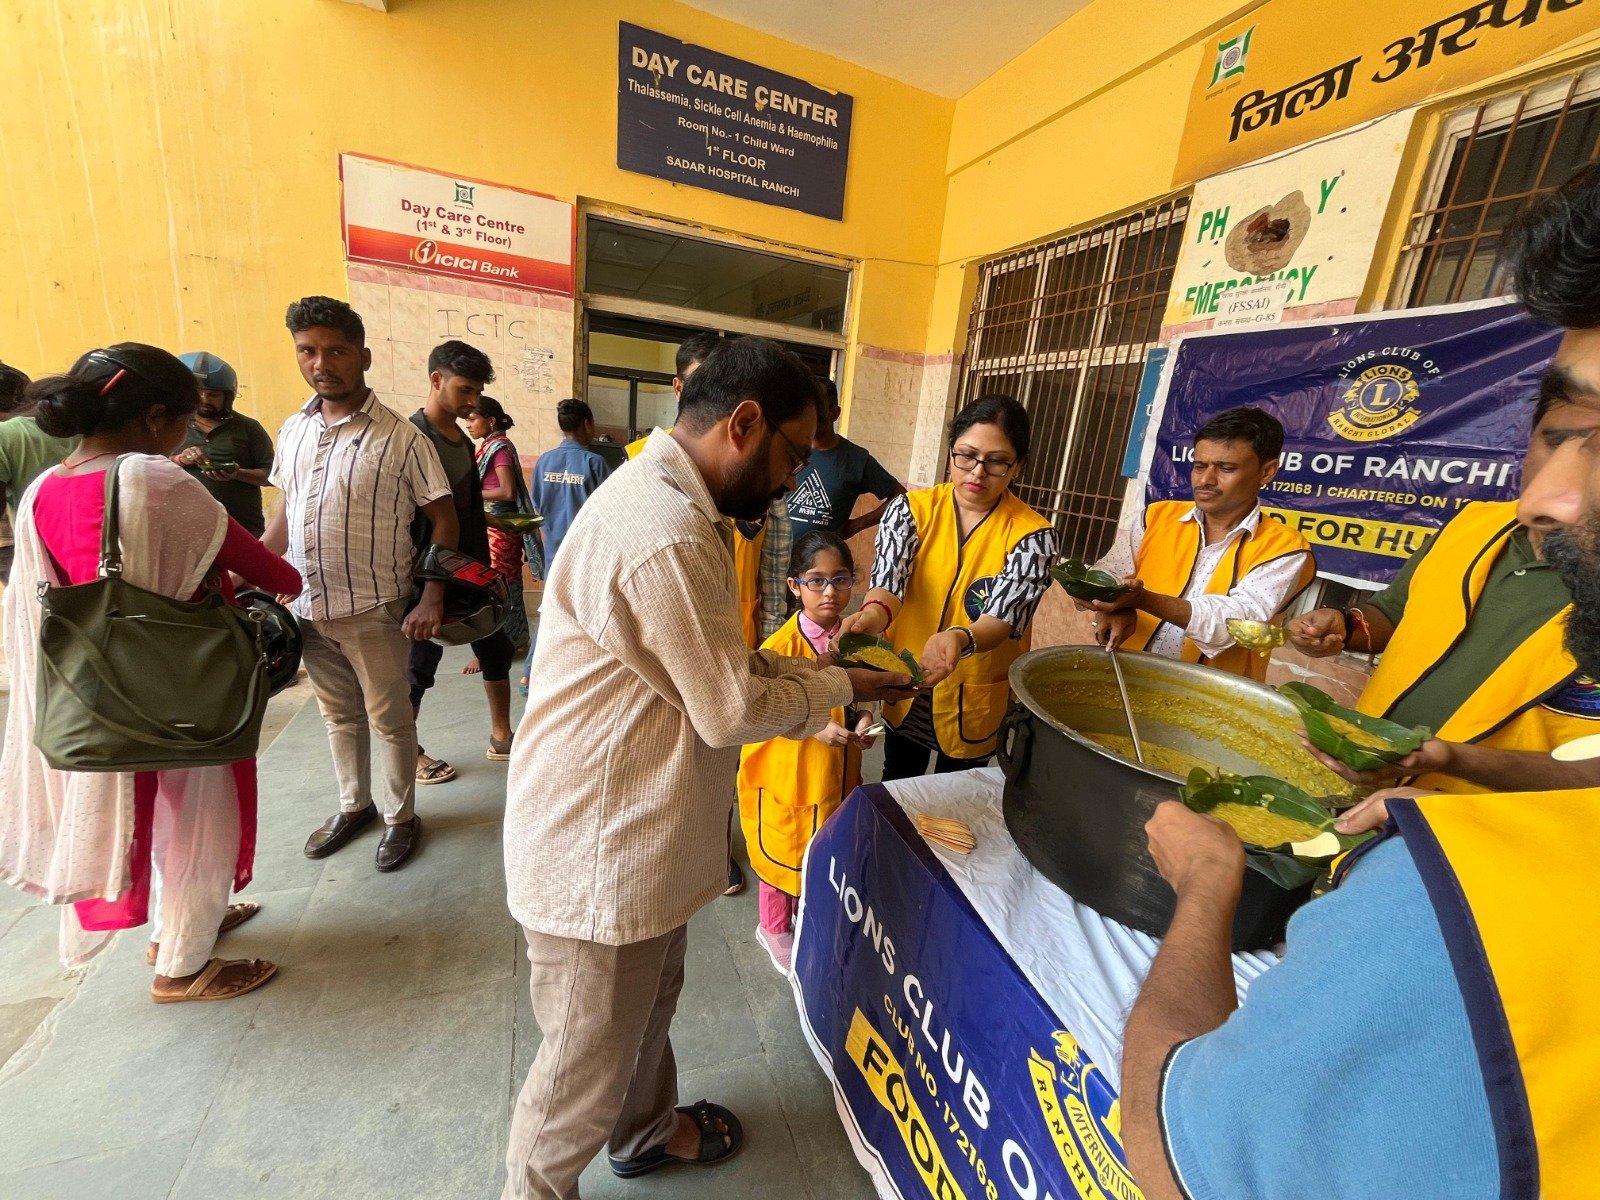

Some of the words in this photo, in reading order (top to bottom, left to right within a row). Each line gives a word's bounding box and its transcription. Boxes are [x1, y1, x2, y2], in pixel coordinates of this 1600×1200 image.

[632, 46, 680, 77] DAY
[686, 64, 748, 100] CARE
[754, 86, 838, 127] CENTER
[1229, 55, 1363, 143] जिला
[628, 78, 692, 109] Thalassemia,
[694, 98, 722, 116] Sickle
[724, 107, 742, 121] Cell
[743, 113, 777, 132] Anemia
[778, 123, 786, 134] &
[787, 125, 838, 150] Haemophilia
[678, 116, 708, 133] Room
[743, 135, 768, 149] Child
[770, 142, 795, 157] Ward
[666, 155, 705, 173] SADAR
[708, 165, 759, 187] HOSPITAL
[761, 179, 800, 197] RANCHI
[722, 149, 766, 171] FLOOR
[401, 198, 431, 218] Day
[436, 206, 471, 224] Care
[476, 214, 525, 235] Centre
[416, 219, 437, 232] (1st
[441, 224, 451, 236] &
[455, 227, 472, 238] 3rd
[475, 231, 512, 249] Floor)
[434, 253, 478, 271] ICICI
[480, 261, 520, 278] Bank
[1228, 297, 1271, 315] (FSSAI)
[1339, 350, 1375, 379] LIONS
[1382, 347, 1421, 360] CLUB
[1423, 360, 1440, 375] OF
[1364, 366, 1409, 380] LIONS
[1370, 383, 1391, 406] L
[1333, 418, 1363, 438] RANCHI
[1367, 418, 1411, 438] GLOBAL
[1311, 453, 1354, 475] OF
[1364, 455, 1512, 488] RANCHI
[1272, 481, 1312, 494] 172168
[1327, 486, 1417, 505] CHARTERED
[1420, 495, 1448, 509] ON
[1298, 516, 1365, 546] FOR
[828, 856, 896, 975] LIONS
[903, 974, 991, 1130] CLUB
[884, 994, 915, 1055] CLUB
[943, 1101, 999, 1200] 172168
[1036, 1077, 1093, 1198] RANCHI
[1070, 1105, 1142, 1200] INTERNATION
